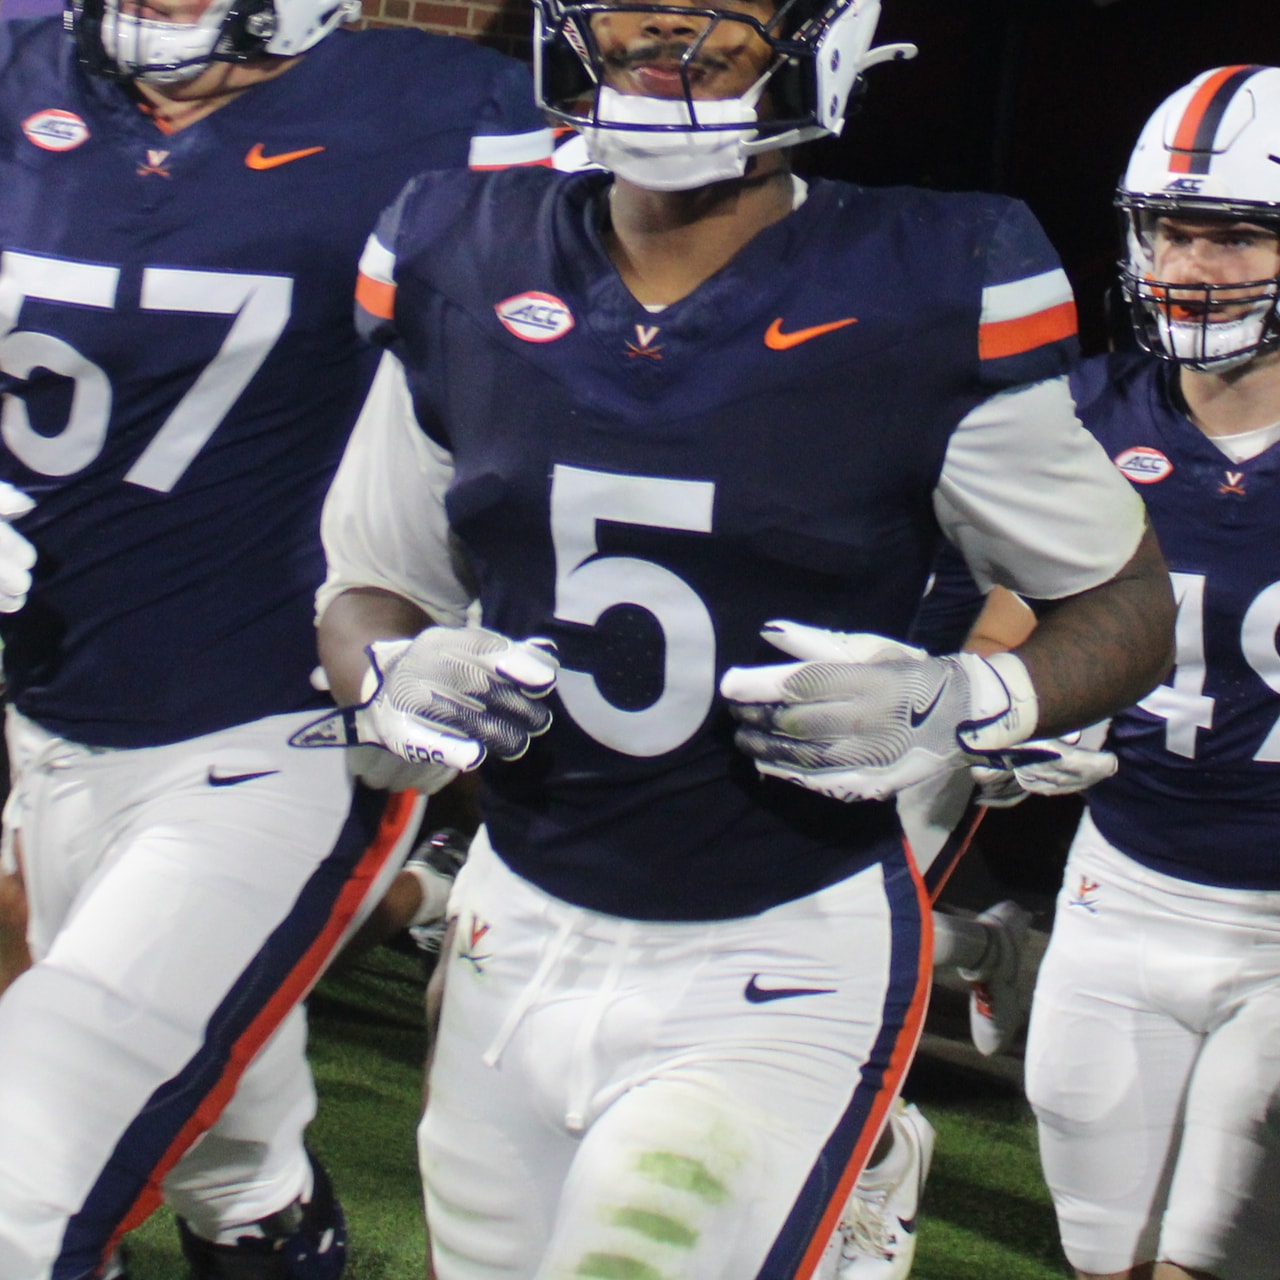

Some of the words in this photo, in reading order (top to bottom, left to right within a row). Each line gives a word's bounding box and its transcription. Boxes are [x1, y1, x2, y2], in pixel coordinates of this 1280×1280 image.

[507, 302, 565, 332] ACC
[1123, 455, 1164, 473] ACC
[550, 463, 716, 758] 5
